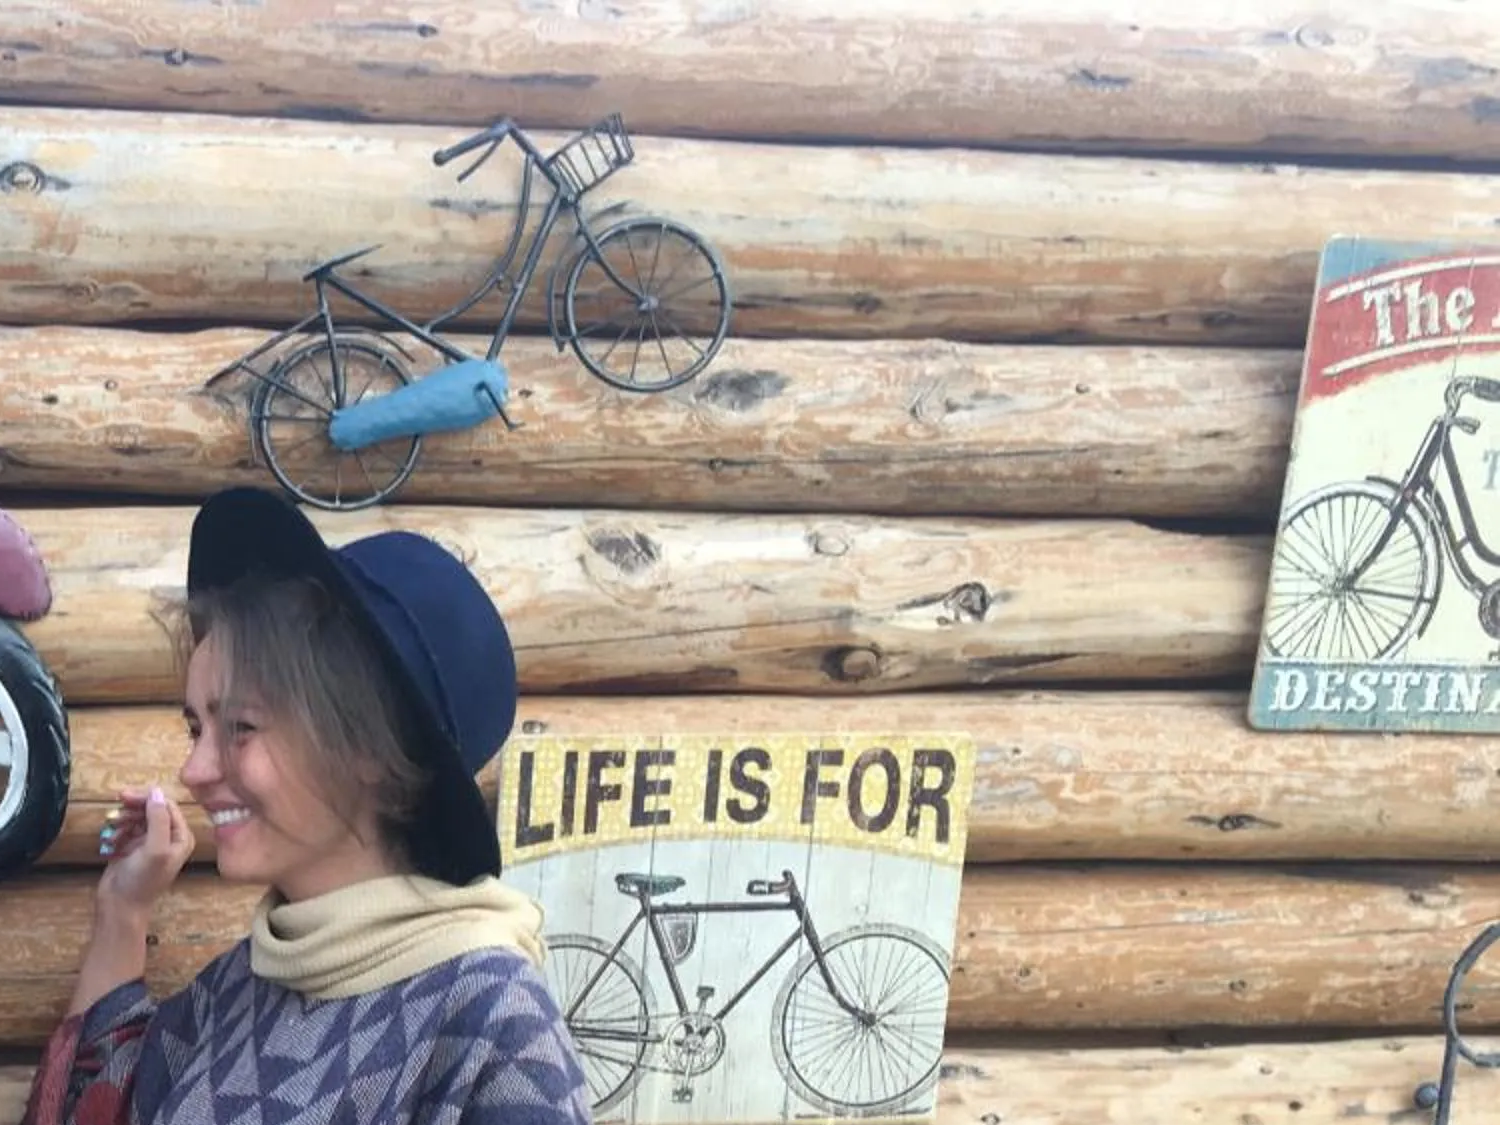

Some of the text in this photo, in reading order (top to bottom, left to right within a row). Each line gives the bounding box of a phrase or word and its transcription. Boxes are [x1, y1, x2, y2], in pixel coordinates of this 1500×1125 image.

[1363, 278, 1475, 346] The
[515, 746, 957, 848] LIFE IS FOR
